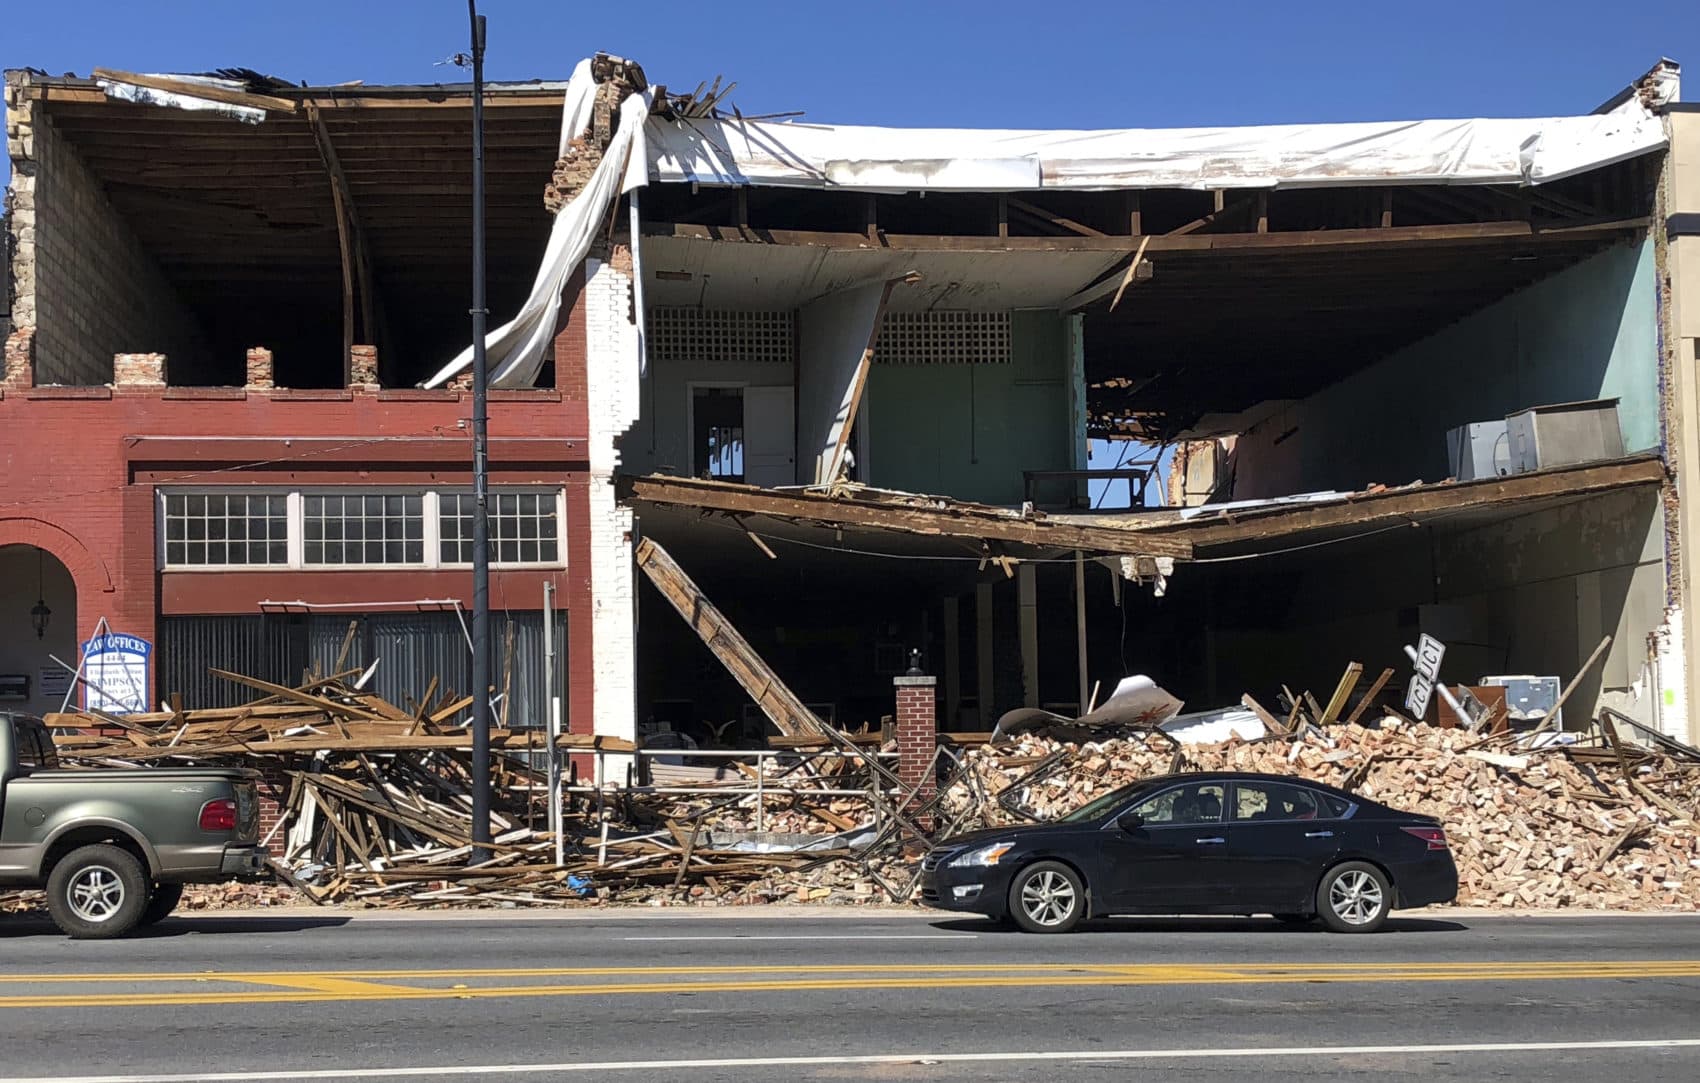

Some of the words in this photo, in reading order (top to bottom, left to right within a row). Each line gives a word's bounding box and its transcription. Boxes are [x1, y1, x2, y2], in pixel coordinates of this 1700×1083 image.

[108, 636, 146, 653] OFFICES
[1420, 639, 1440, 677] JCT
[1412, 678, 1429, 715] JCT
